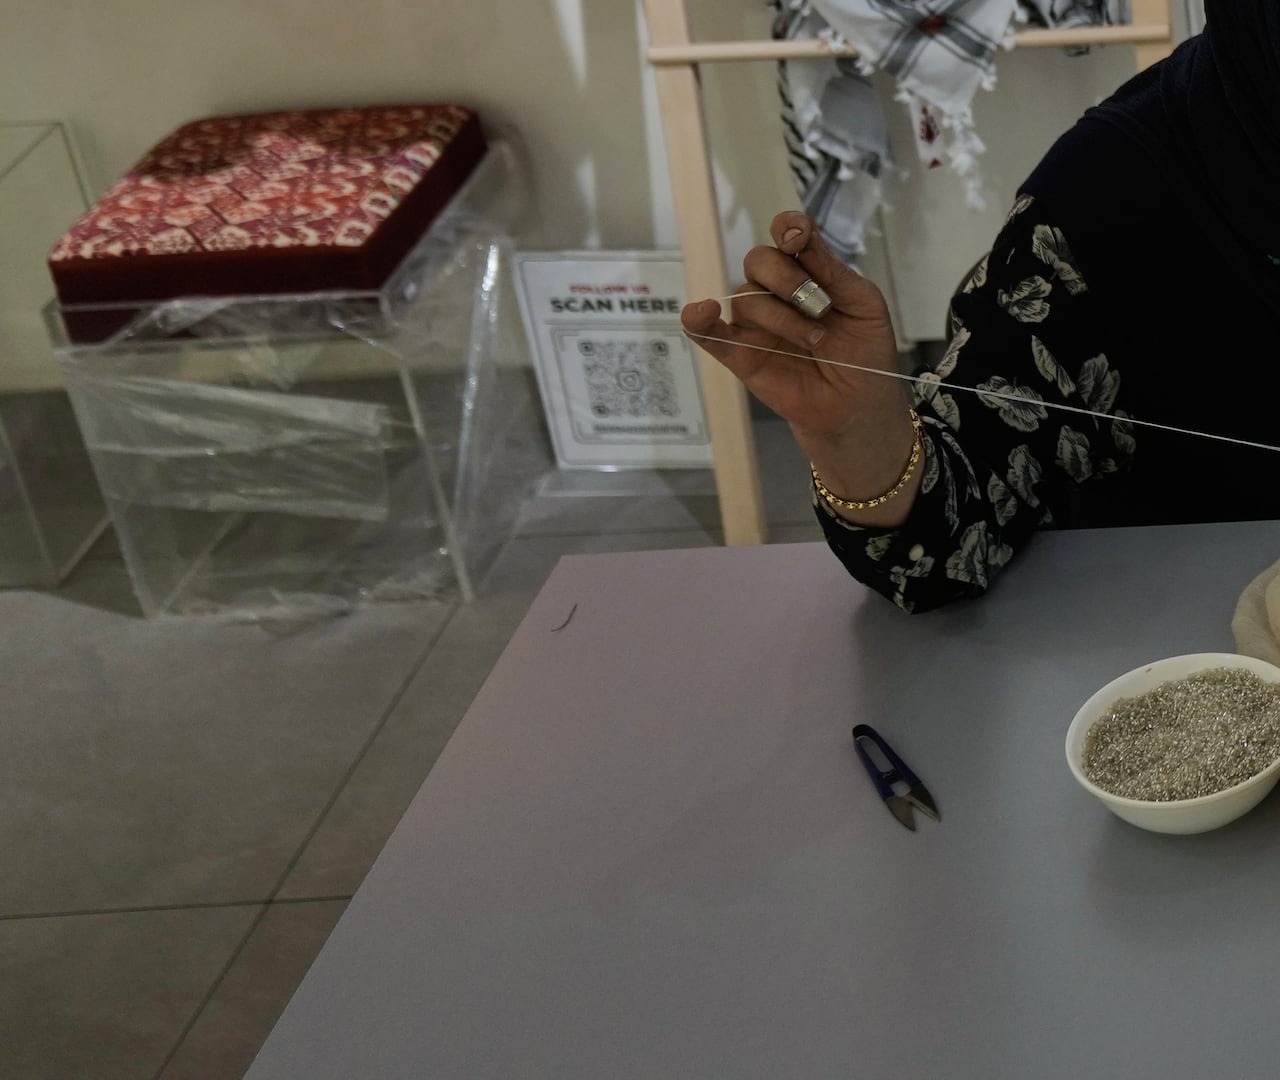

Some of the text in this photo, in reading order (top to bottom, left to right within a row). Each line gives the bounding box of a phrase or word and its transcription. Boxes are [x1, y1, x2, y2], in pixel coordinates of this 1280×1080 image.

[569, 284, 649, 294] FOLLOW US
[550, 297, 680, 313] SCAN HERE
